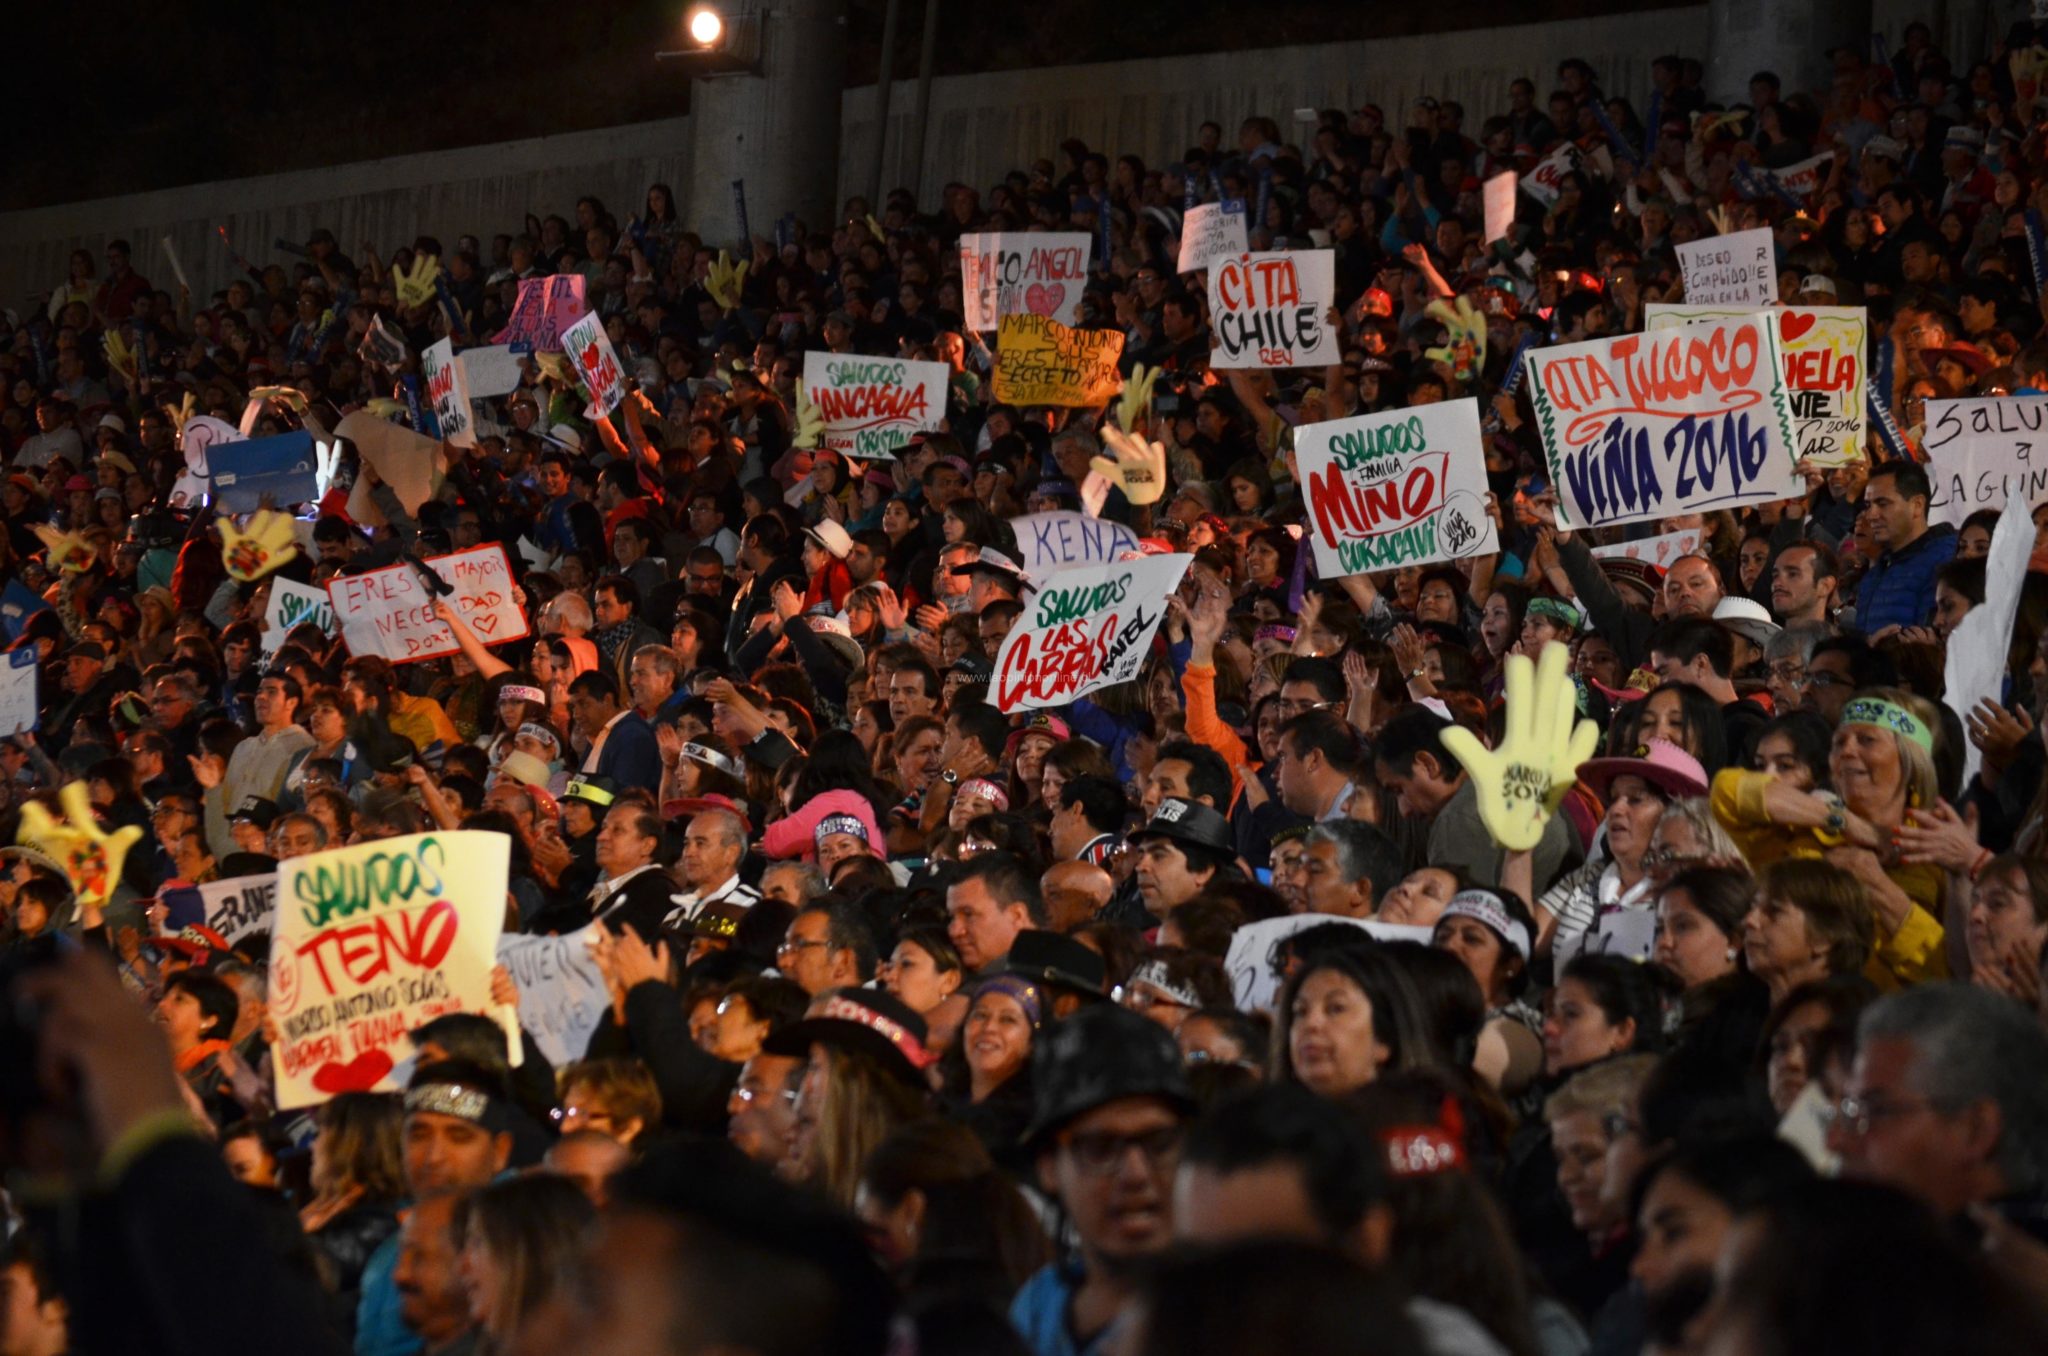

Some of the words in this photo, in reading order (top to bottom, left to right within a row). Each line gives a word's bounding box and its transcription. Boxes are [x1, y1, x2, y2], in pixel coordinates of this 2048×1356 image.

[1024, 248, 1085, 280] ANGOL
[1695, 251, 1731, 268] DESEO
[1736, 288, 1750, 301] LA
[1002, 314, 1066, 342] MARCO
[1068, 331, 1123, 353] ANTONIO
[1221, 306, 1318, 355] CHILE
[826, 361, 907, 387] SALUDOS
[1000, 366, 1081, 384] SECRETO
[1001, 348, 1047, 369] ERES
[1543, 354, 1620, 412] QTA
[1329, 415, 1427, 471] SALUDOS
[1826, 417, 1861, 432] 2016
[1358, 458, 1403, 481] FAMILIA
[1663, 410, 1768, 500] 2016
[1032, 519, 1136, 566] KENA
[346, 571, 413, 614] ERES
[453, 555, 504, 585] MAYOR
[1037, 573, 1133, 629] SALUDOS
[1040, 617, 1090, 653] LAS
[294, 836, 446, 928] SALUDOS
[295, 899, 459, 996] TENO
